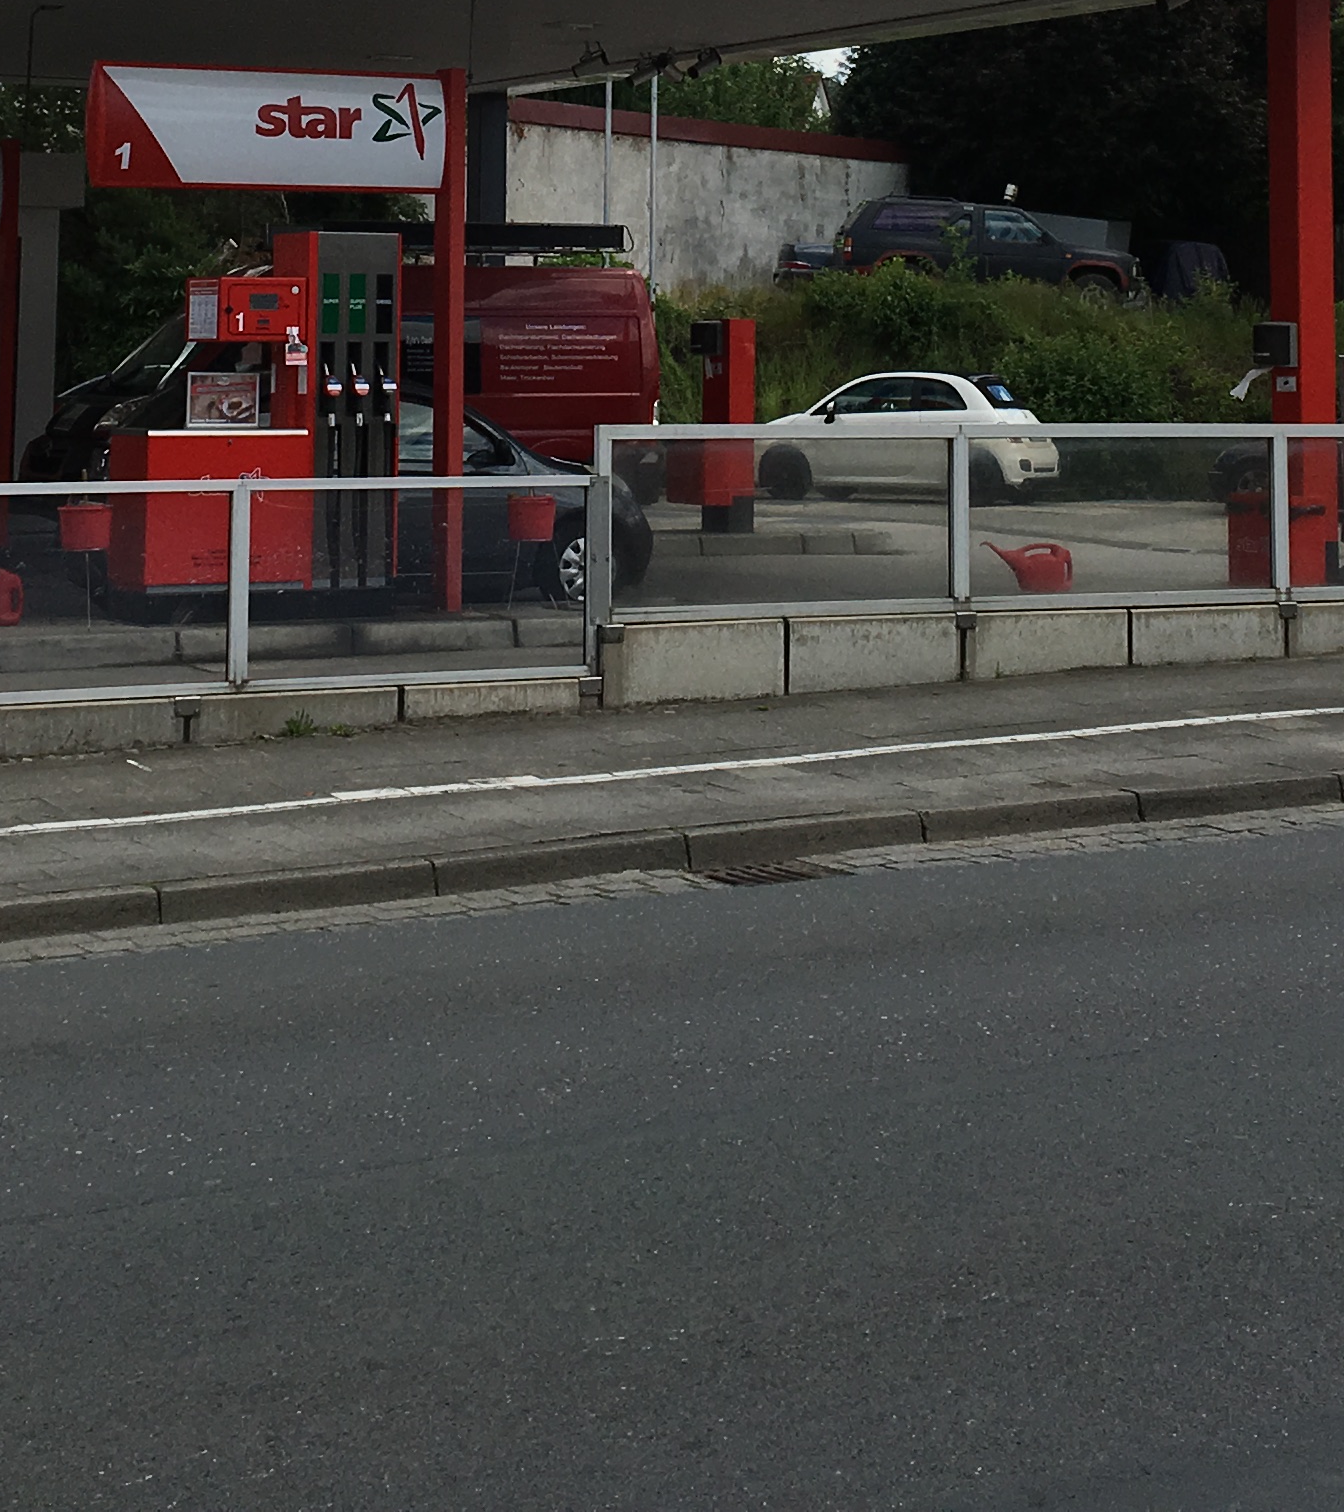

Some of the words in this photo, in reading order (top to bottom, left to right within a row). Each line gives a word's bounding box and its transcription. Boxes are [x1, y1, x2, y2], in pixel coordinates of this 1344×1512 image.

[256, 95, 362, 140] star
[114, 142, 131, 170] 1
[235, 311, 244, 332] 1
